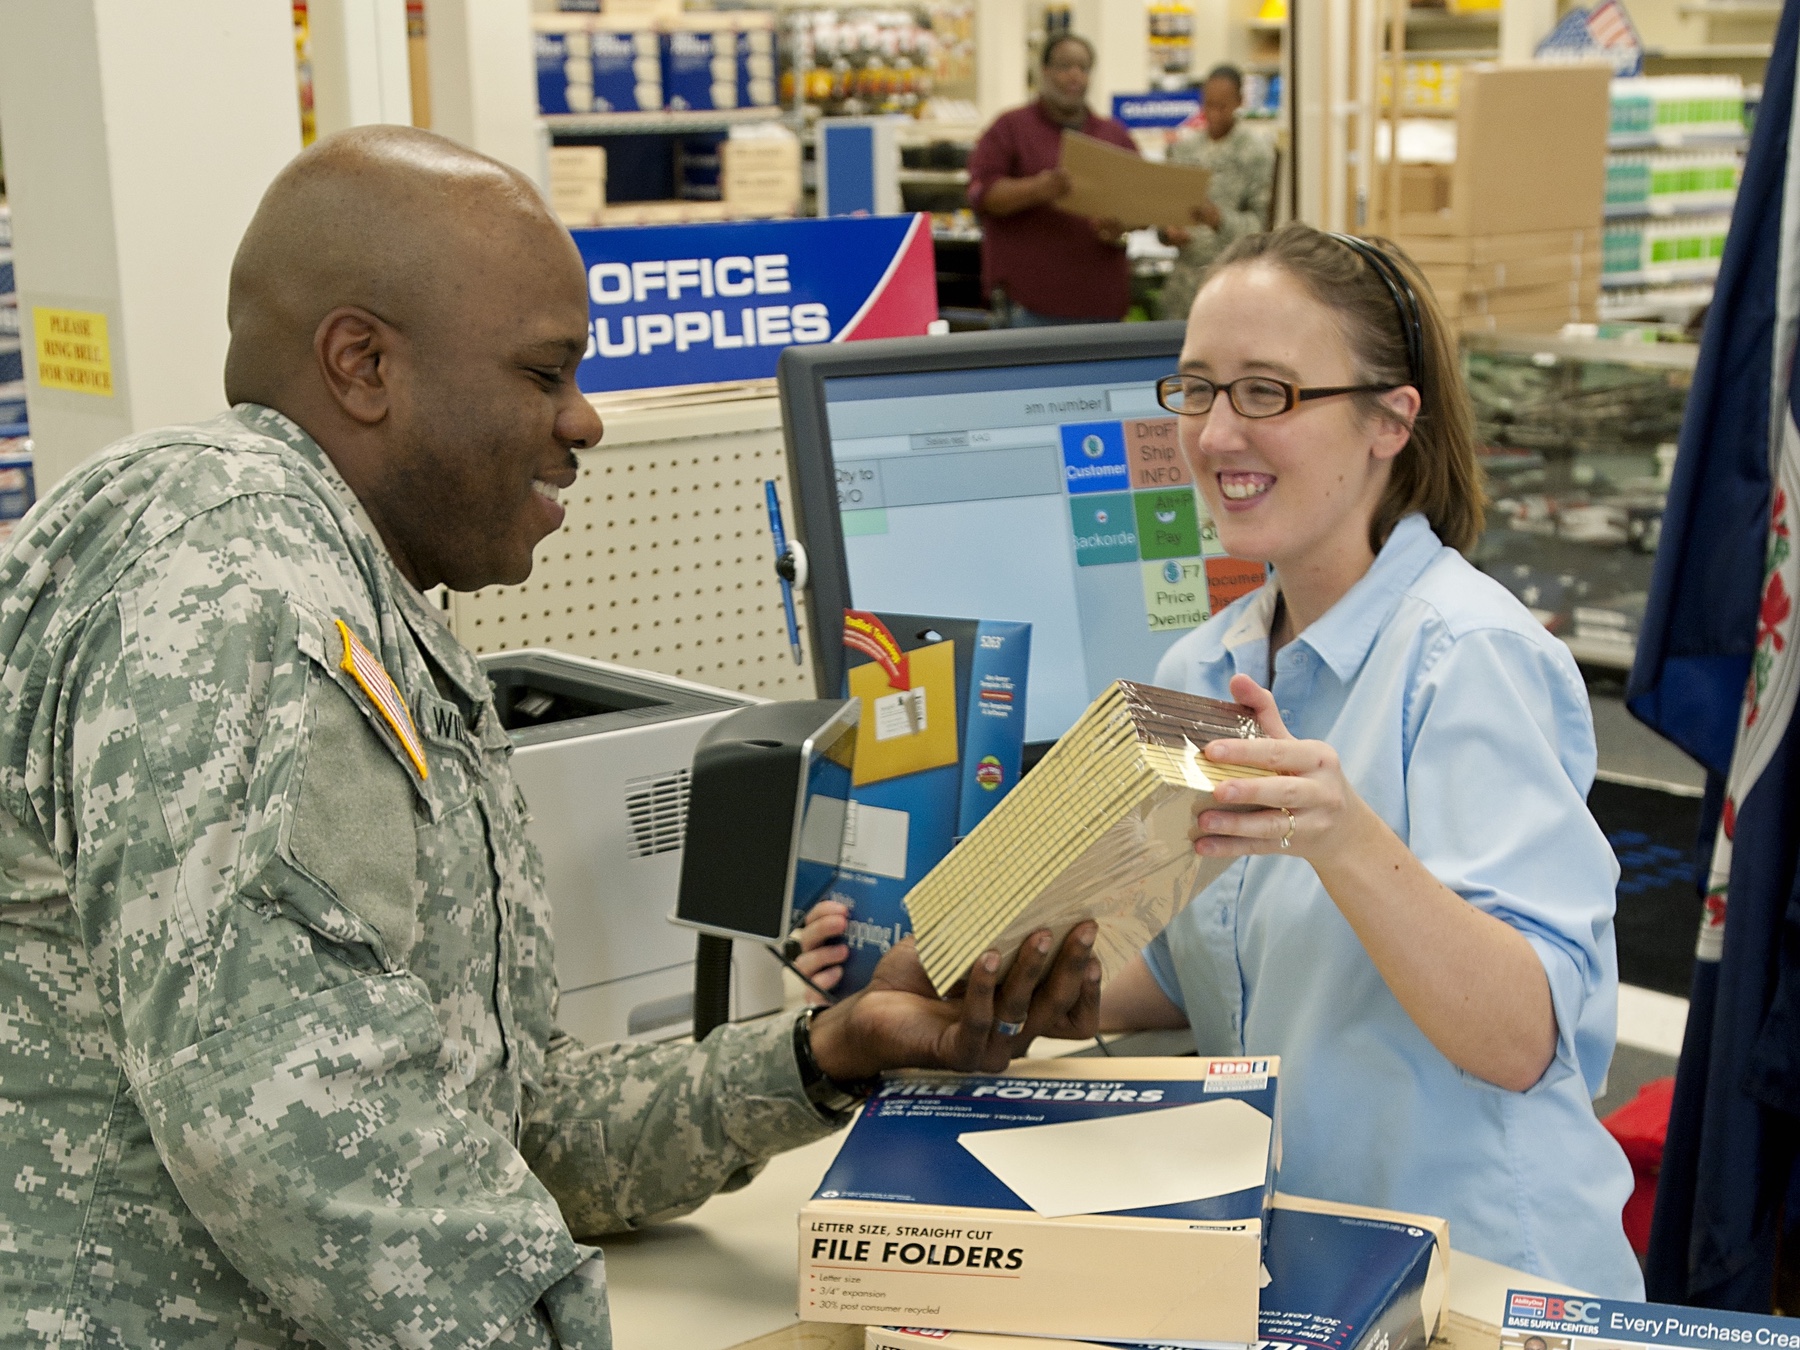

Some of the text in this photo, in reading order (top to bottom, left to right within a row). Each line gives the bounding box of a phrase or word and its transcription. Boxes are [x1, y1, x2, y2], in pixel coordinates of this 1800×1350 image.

[588, 253, 791, 305] OFFICE
[49, 315, 91, 336] PLEASE
[43, 339, 103, 362] RING BELL
[40, 363, 111, 389] FOR SERVICE
[1048, 397, 1103, 413] number
[1141, 445, 1176, 463] Ship
[859, 467, 874, 480] to
[1066, 464, 1126, 479] Customer
[1140, 466, 1182, 484] INFO
[1156, 530, 1182, 546] Pay
[1183, 564, 1200, 579] F7
[1156, 591, 1196, 605] Price
[1148, 609, 1209, 627] Override
[1213, 1063, 1250, 1074] 100
[997, 1079, 1082, 1090] STRAIGHT
[1087, 1082, 1125, 1091] CUT
[878, 1084, 1166, 1103] FILE FOLDERS
[935, 1111, 991, 1119] consumer
[994, 1112, 1045, 1122] recycled
[811, 1222, 993, 1241] LETTER SIZE, STRAIGHT CUT
[811, 1238, 1024, 1270] FILE FOLDERS
[819, 1273, 861, 1284] Letter size
[842, 1289, 887, 1299] expansion
[1514, 1297, 1543, 1307] AbilityOne
[819, 1300, 940, 1316] 30% post consumer recycled
[1282, 1311, 1312, 1321] post
[1545, 1297, 1601, 1324] BSC
[1313, 1316, 1342, 1327] 30%
[1508, 1316, 1600, 1335] BASE SUPPLY CENTERS
[1268, 1327, 1331, 1343] Letter size
[1610, 1312, 1800, 1349] Every Purchase Crea
